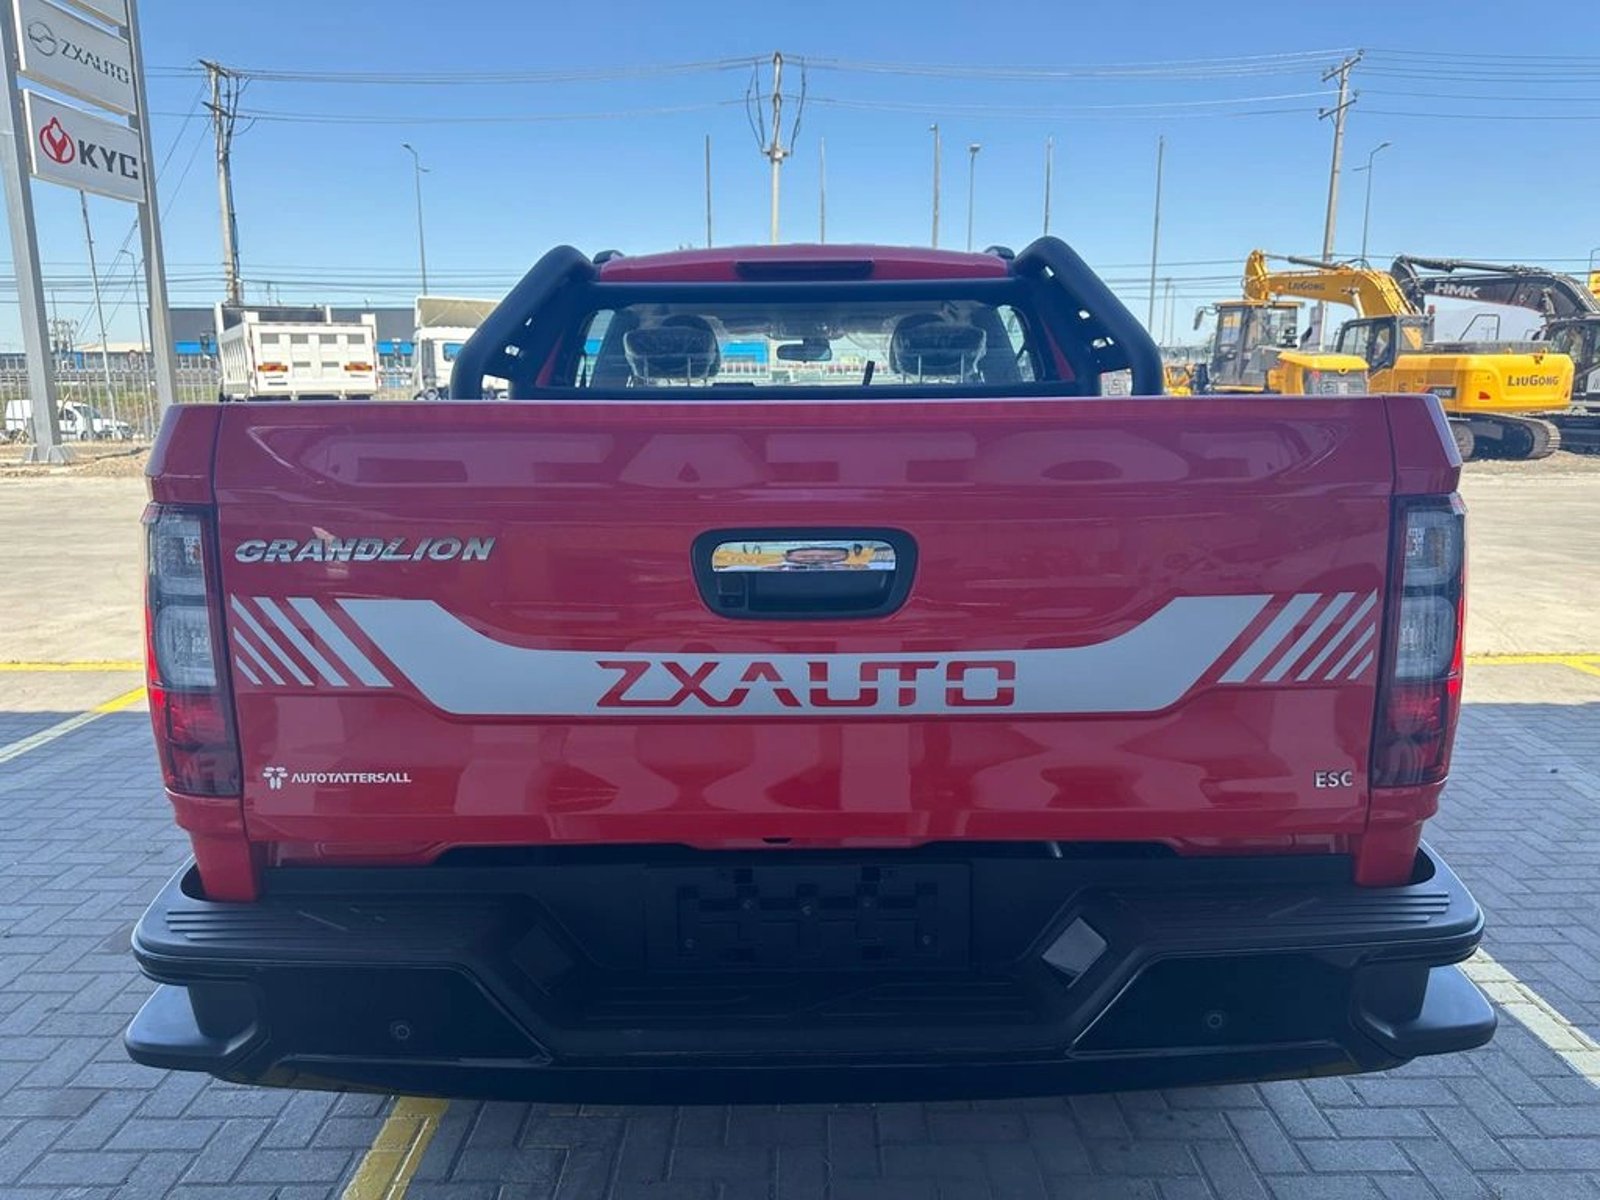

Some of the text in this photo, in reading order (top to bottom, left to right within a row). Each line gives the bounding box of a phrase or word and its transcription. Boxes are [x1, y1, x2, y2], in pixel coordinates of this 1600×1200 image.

[77, 139, 139, 180] KYC
[1433, 282, 1481, 299] HMK
[234, 536, 496, 564] GRANDLION
[596, 660, 1017, 708] ZXAUTO
[291, 771, 412, 785] AUTOTATTERSALL
[1314, 770, 1354, 788] ESC
